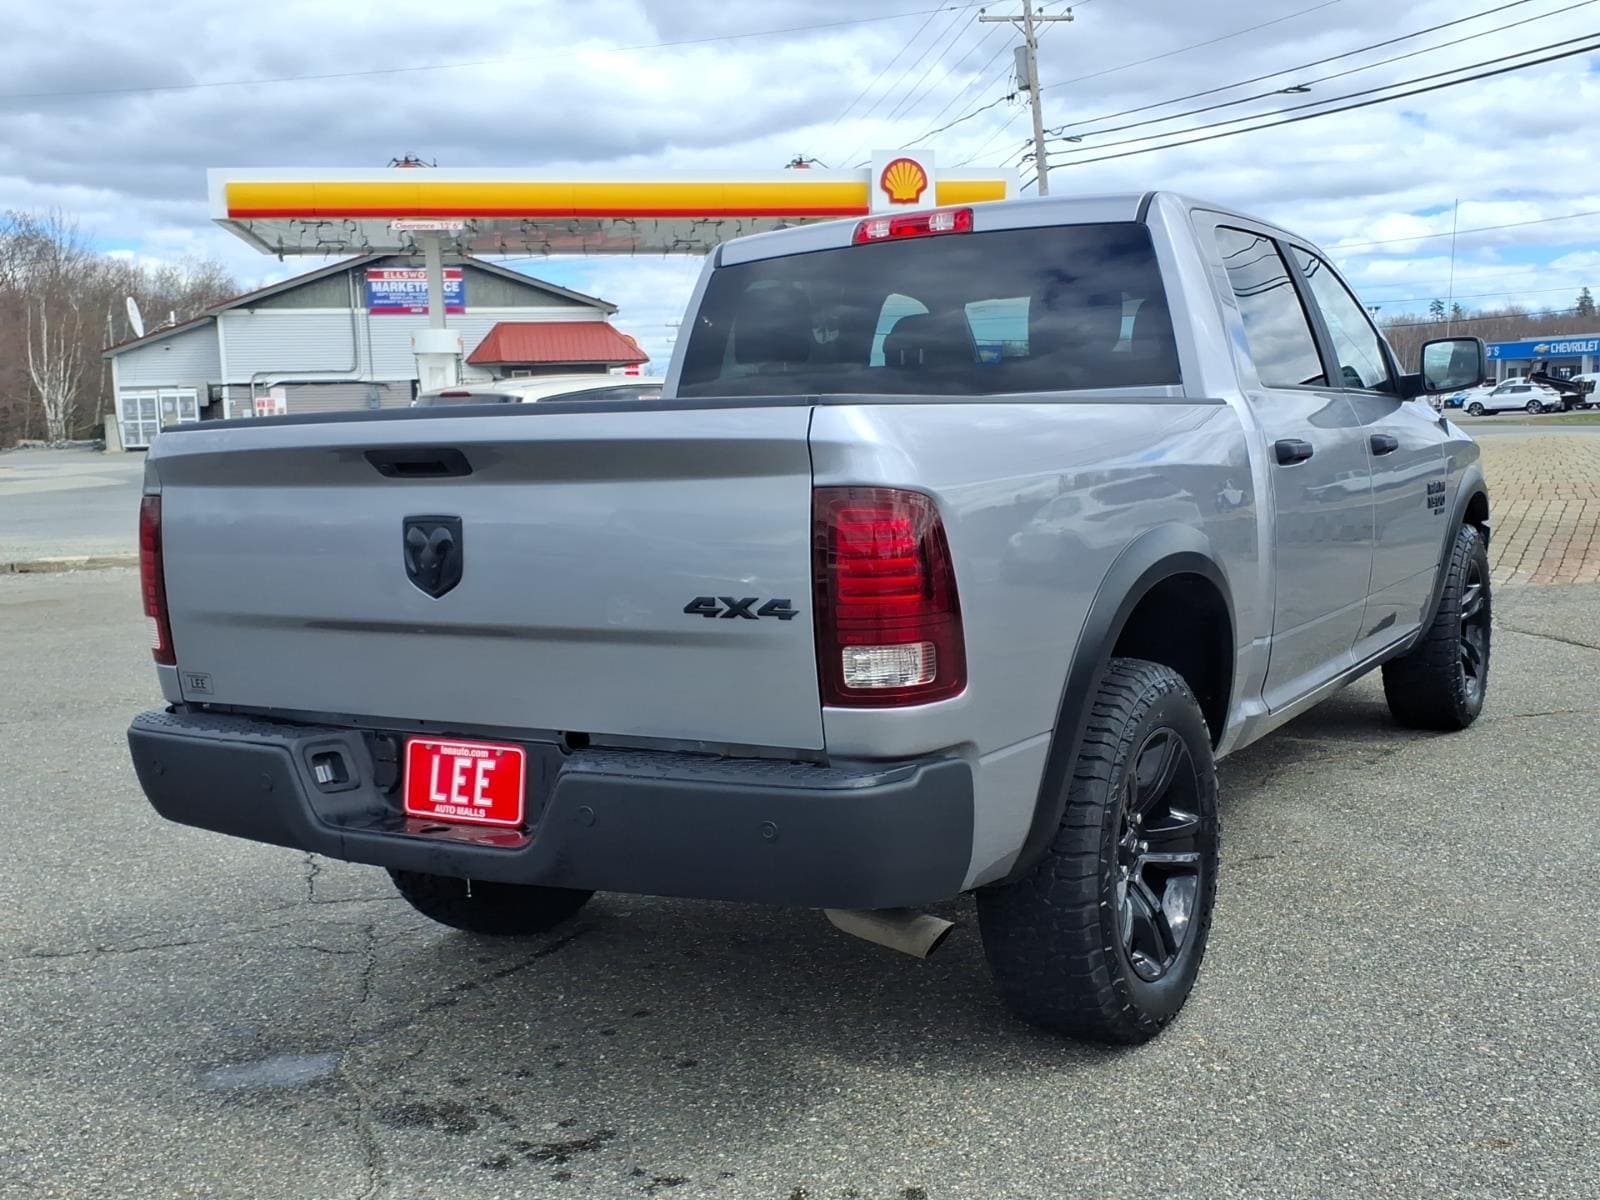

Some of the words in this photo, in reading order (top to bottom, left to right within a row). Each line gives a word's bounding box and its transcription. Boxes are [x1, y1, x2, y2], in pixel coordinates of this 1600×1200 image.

[1550, 341, 1600, 353] CHEVROLET
[683, 597, 800, 621] 4X4
[190, 678, 206, 689] LEE
[441, 745, 489, 758] leeauto.com
[429, 754, 497, 807] LEE
[434, 804, 456, 815] AUTO
[456, 806, 486, 818] MALLS
